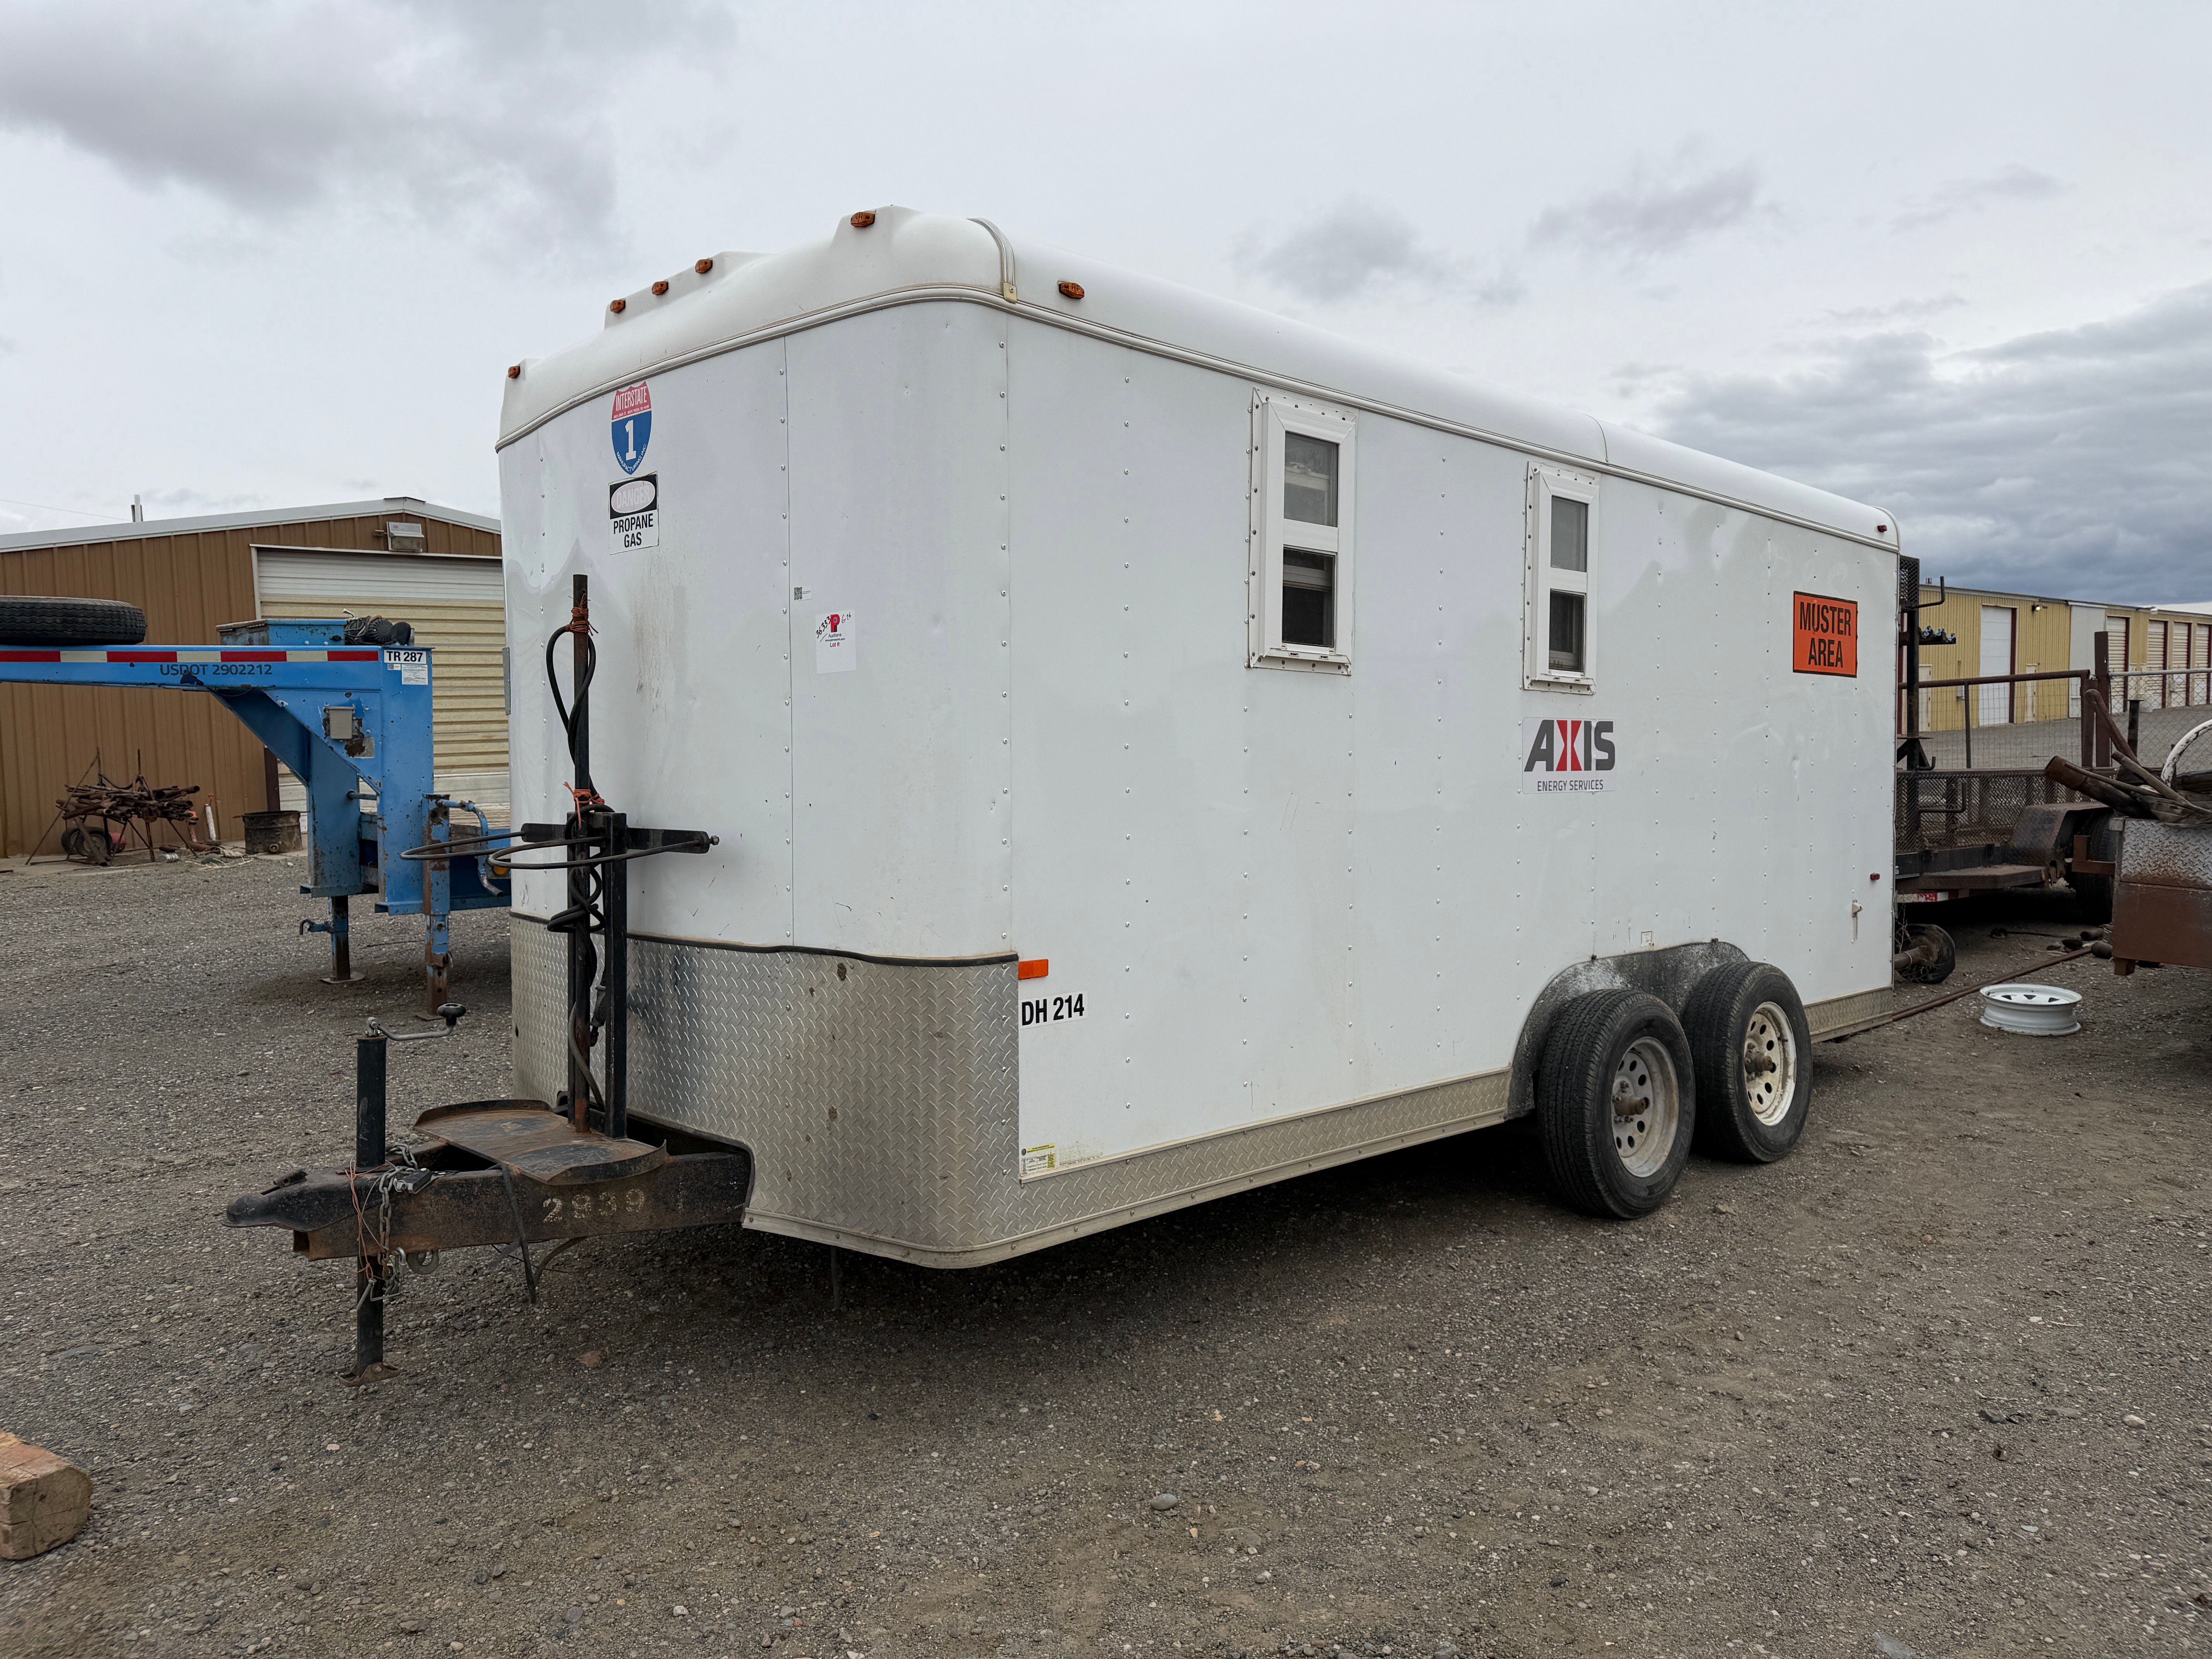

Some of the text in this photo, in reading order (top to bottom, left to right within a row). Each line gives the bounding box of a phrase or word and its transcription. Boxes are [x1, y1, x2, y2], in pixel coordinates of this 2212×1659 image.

[616, 386, 647, 411] INTERSTATE
[625, 420, 636, 460] 1
[617, 451, 642, 472] MANUFACTURING
[616, 485, 651, 510] DANGER
[613, 513, 653, 534] PROPANE
[624, 532, 642, 548] GAS
[1800, 601, 1851, 636] MUSTER
[386, 651, 423, 662] TR 287
[1808, 638, 1843, 668] AREA
[160, 664, 272, 675] USDOT 2902212
[1524, 720, 1615, 771] AXIS
[1537, 780, 1603, 792] ENERGY SERVICES
[1022, 993, 1084, 1026] DH 214
